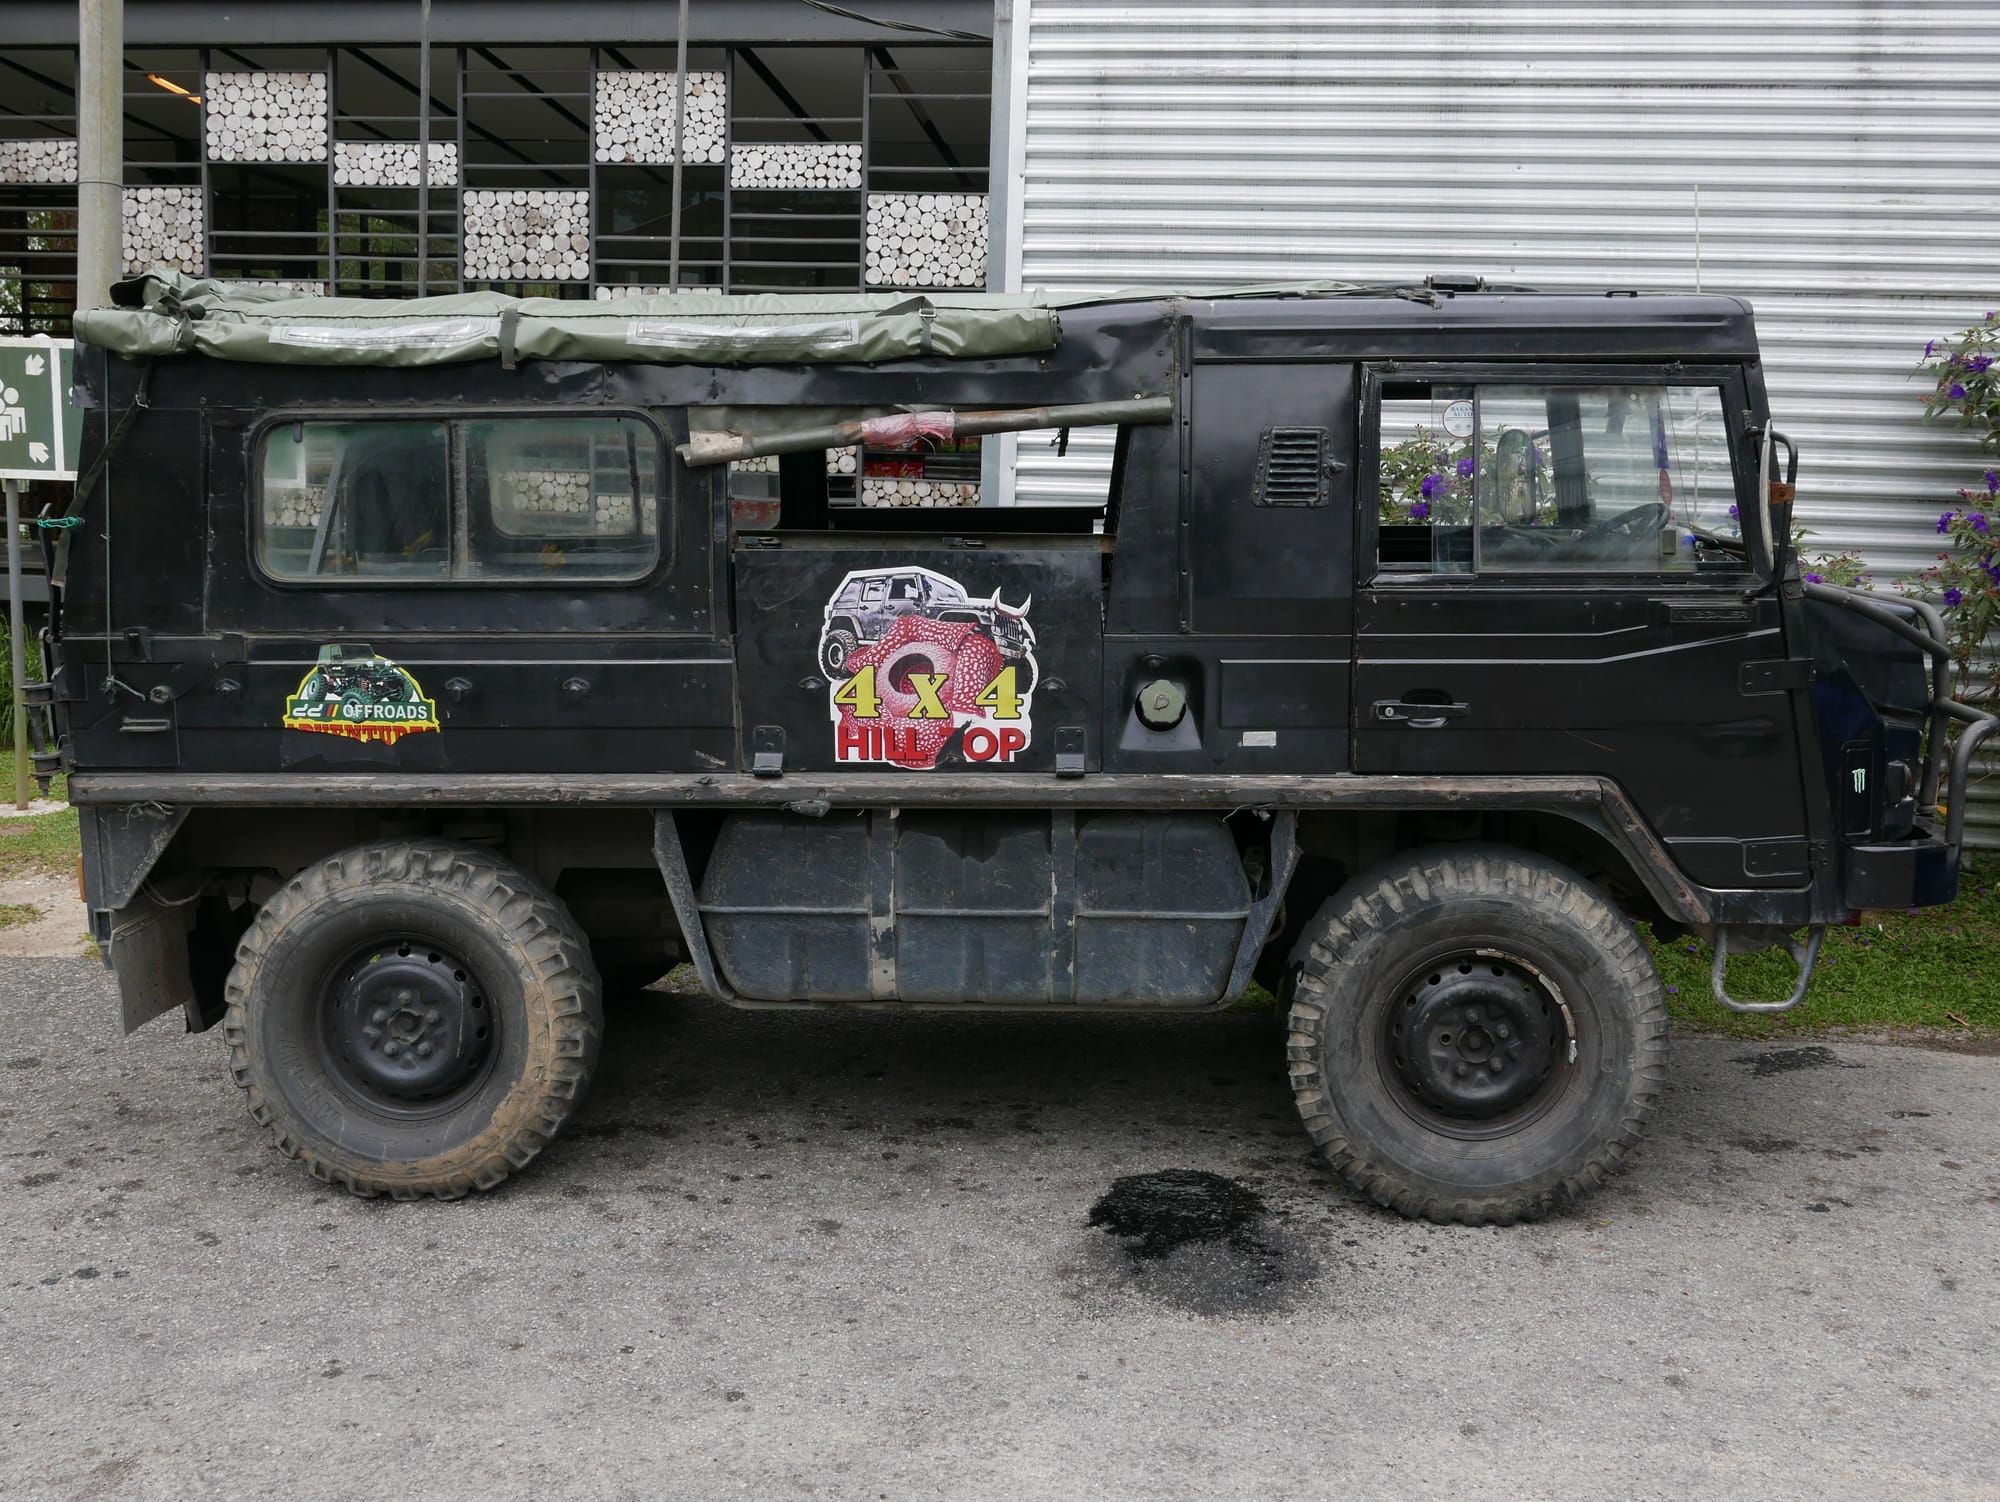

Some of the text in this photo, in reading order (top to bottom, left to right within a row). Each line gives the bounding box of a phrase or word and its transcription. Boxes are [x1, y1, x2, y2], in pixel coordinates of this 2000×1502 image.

[834, 665, 883, 718] 4
[975, 666, 1024, 719] 4
[342, 704, 428, 719] OFFROADS
[837, 726, 927, 761] HILL
